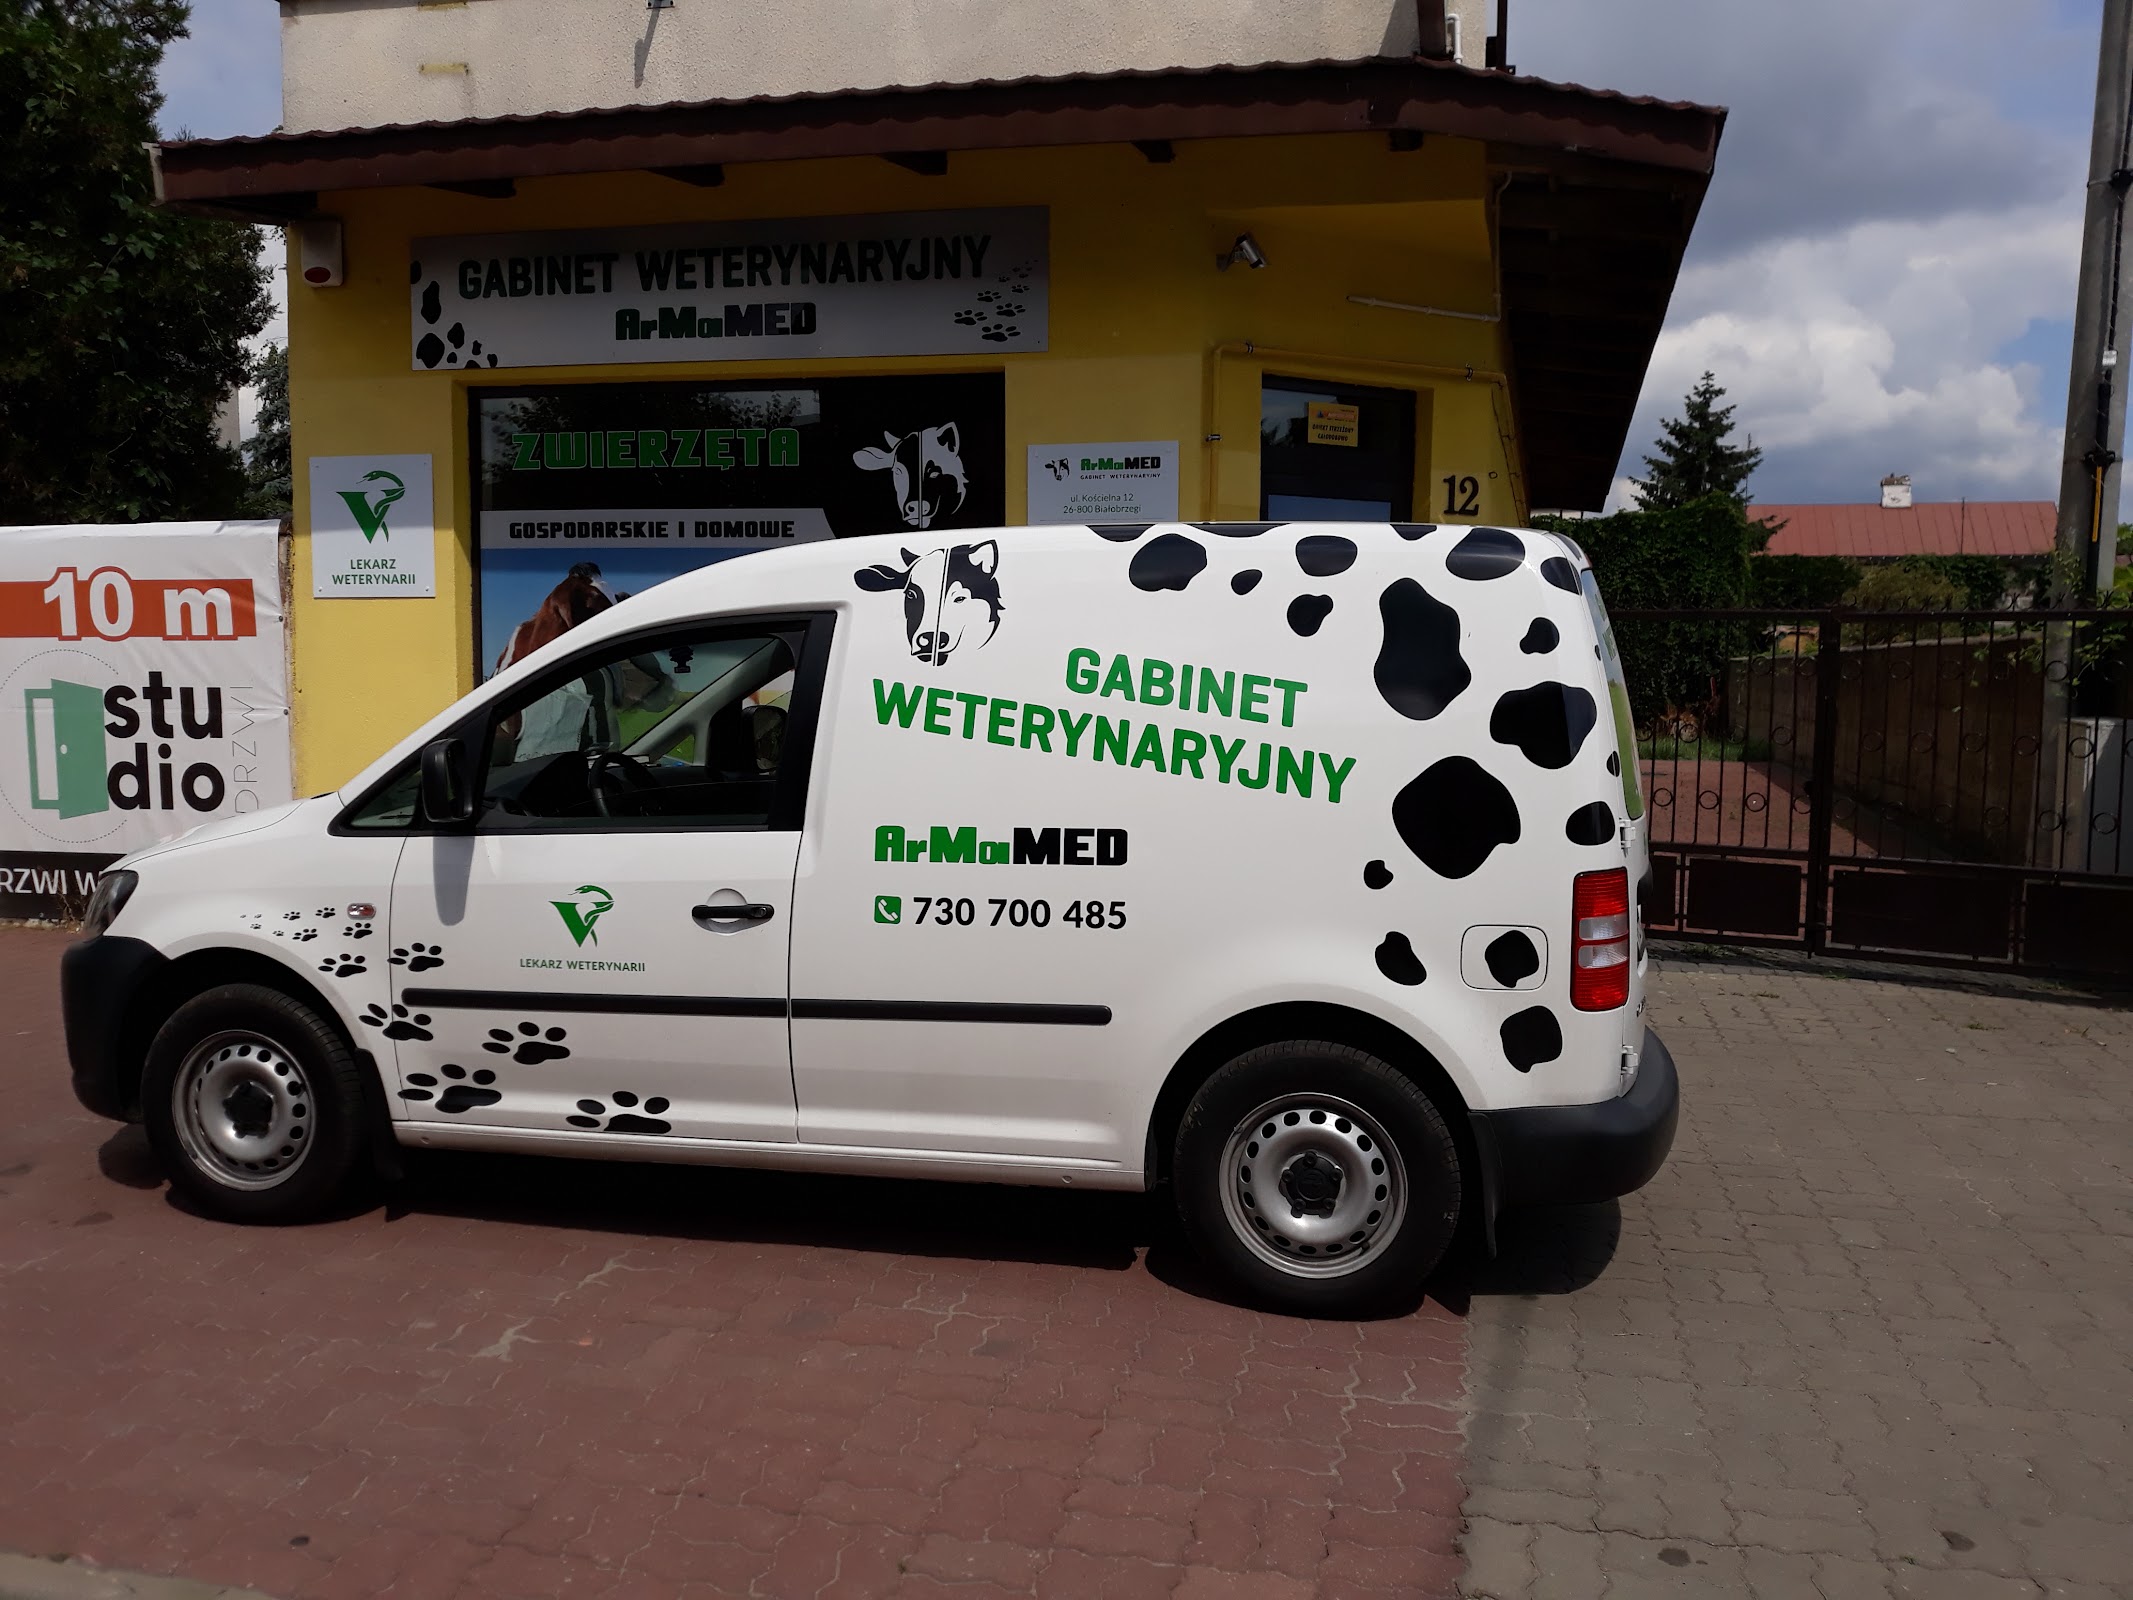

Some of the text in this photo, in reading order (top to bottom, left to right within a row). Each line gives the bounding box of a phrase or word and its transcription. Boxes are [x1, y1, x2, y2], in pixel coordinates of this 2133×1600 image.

[457, 234, 993, 299] GABINET WETERYNARYJNY
[615, 301, 818, 341] ArMaMED
[512, 427, 800, 471] ZWIERZĘTA
[1080, 456, 1161, 471] ArMaMED
[1063, 504, 1142, 515] 26-800 Białobrzegi
[1070, 493, 1134, 503] ul. Kościelna 12
[1442, 474, 1480, 517] 12
[509, 520, 796, 539] GOSPODARSKIE I DOMOWE
[332, 573, 416, 585] WETERYNARII
[350, 558, 396, 570] LEKARZ
[44, 571, 234, 637] 10 m
[103, 671, 223, 739] stu
[1065, 647, 1308, 728] GABINET
[229, 686, 260, 814] DRZWI
[872, 678, 1356, 804] WETERYNARYJNY
[106, 742, 225, 812] dio
[874, 825, 1128, 866] ArMaMED
[913, 897, 1128, 930] 730 700 485
[519, 958, 646, 972] LEKARZ WETERYNARII
